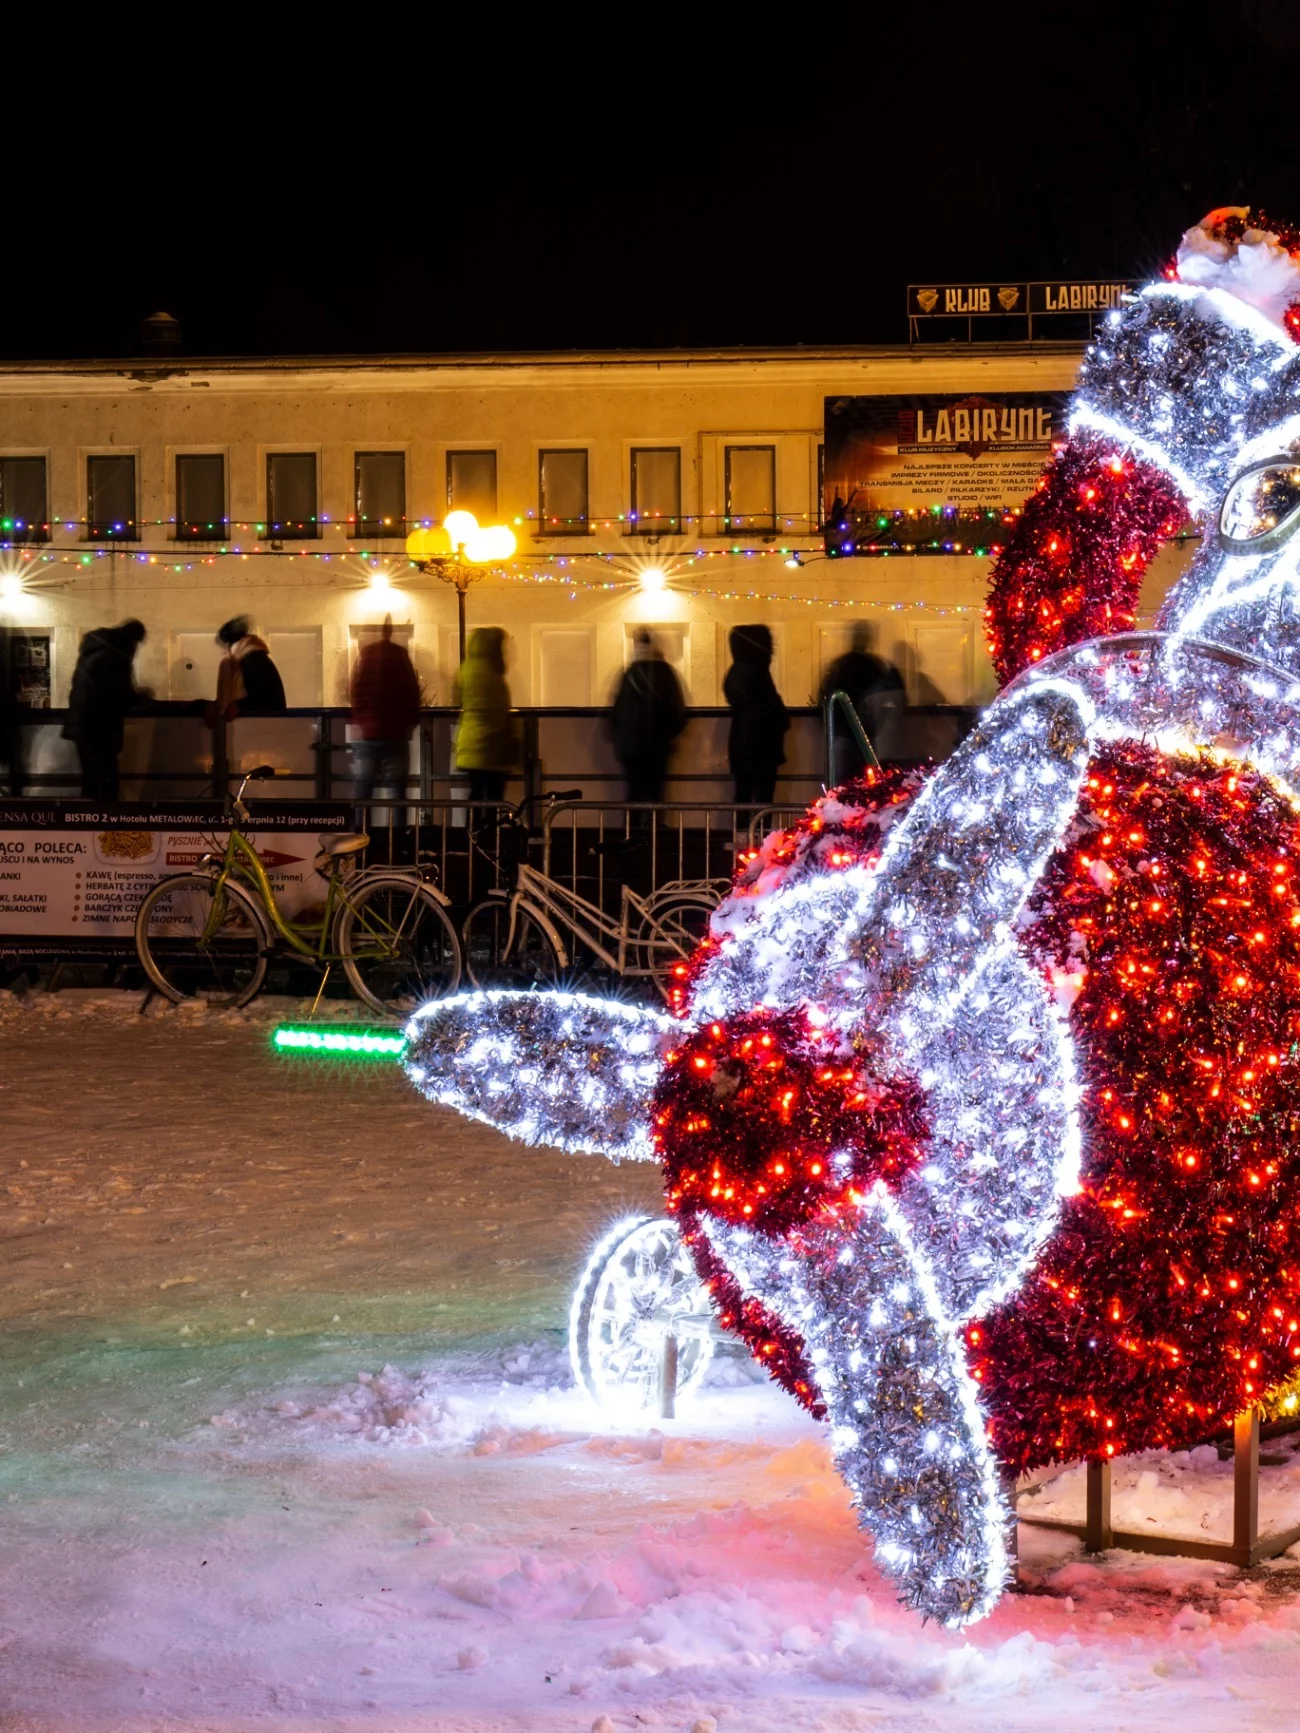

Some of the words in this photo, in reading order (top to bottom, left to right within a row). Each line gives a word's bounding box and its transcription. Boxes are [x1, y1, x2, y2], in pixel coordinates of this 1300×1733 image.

[945, 288, 991, 312] KLUB
[917, 408, 1052, 443] LABIRYNT
[64, 813, 100, 823] BISTRO
[101, 813, 108, 823] 2
[119, 814, 148, 823] Hotelu
[276, 816, 286, 824] 12
[287, 815, 309, 826] (przy
[310, 815, 345, 826] recepcji)
[35, 842, 87, 854] POLECA:
[27, 856, 40, 864] NA
[42, 856, 74, 864] WYNOS
[169, 855, 198, 863] BISTRO
[86, 871, 112, 881] KAWĘ
[114, 871, 156, 881] (espresso,
[85, 882, 125, 892] HERBATĘ
[85, 893, 121, 903] GORĄCĄ
[82, 914, 111, 923] ZIMNE
[112, 915, 137, 923] NAPO
